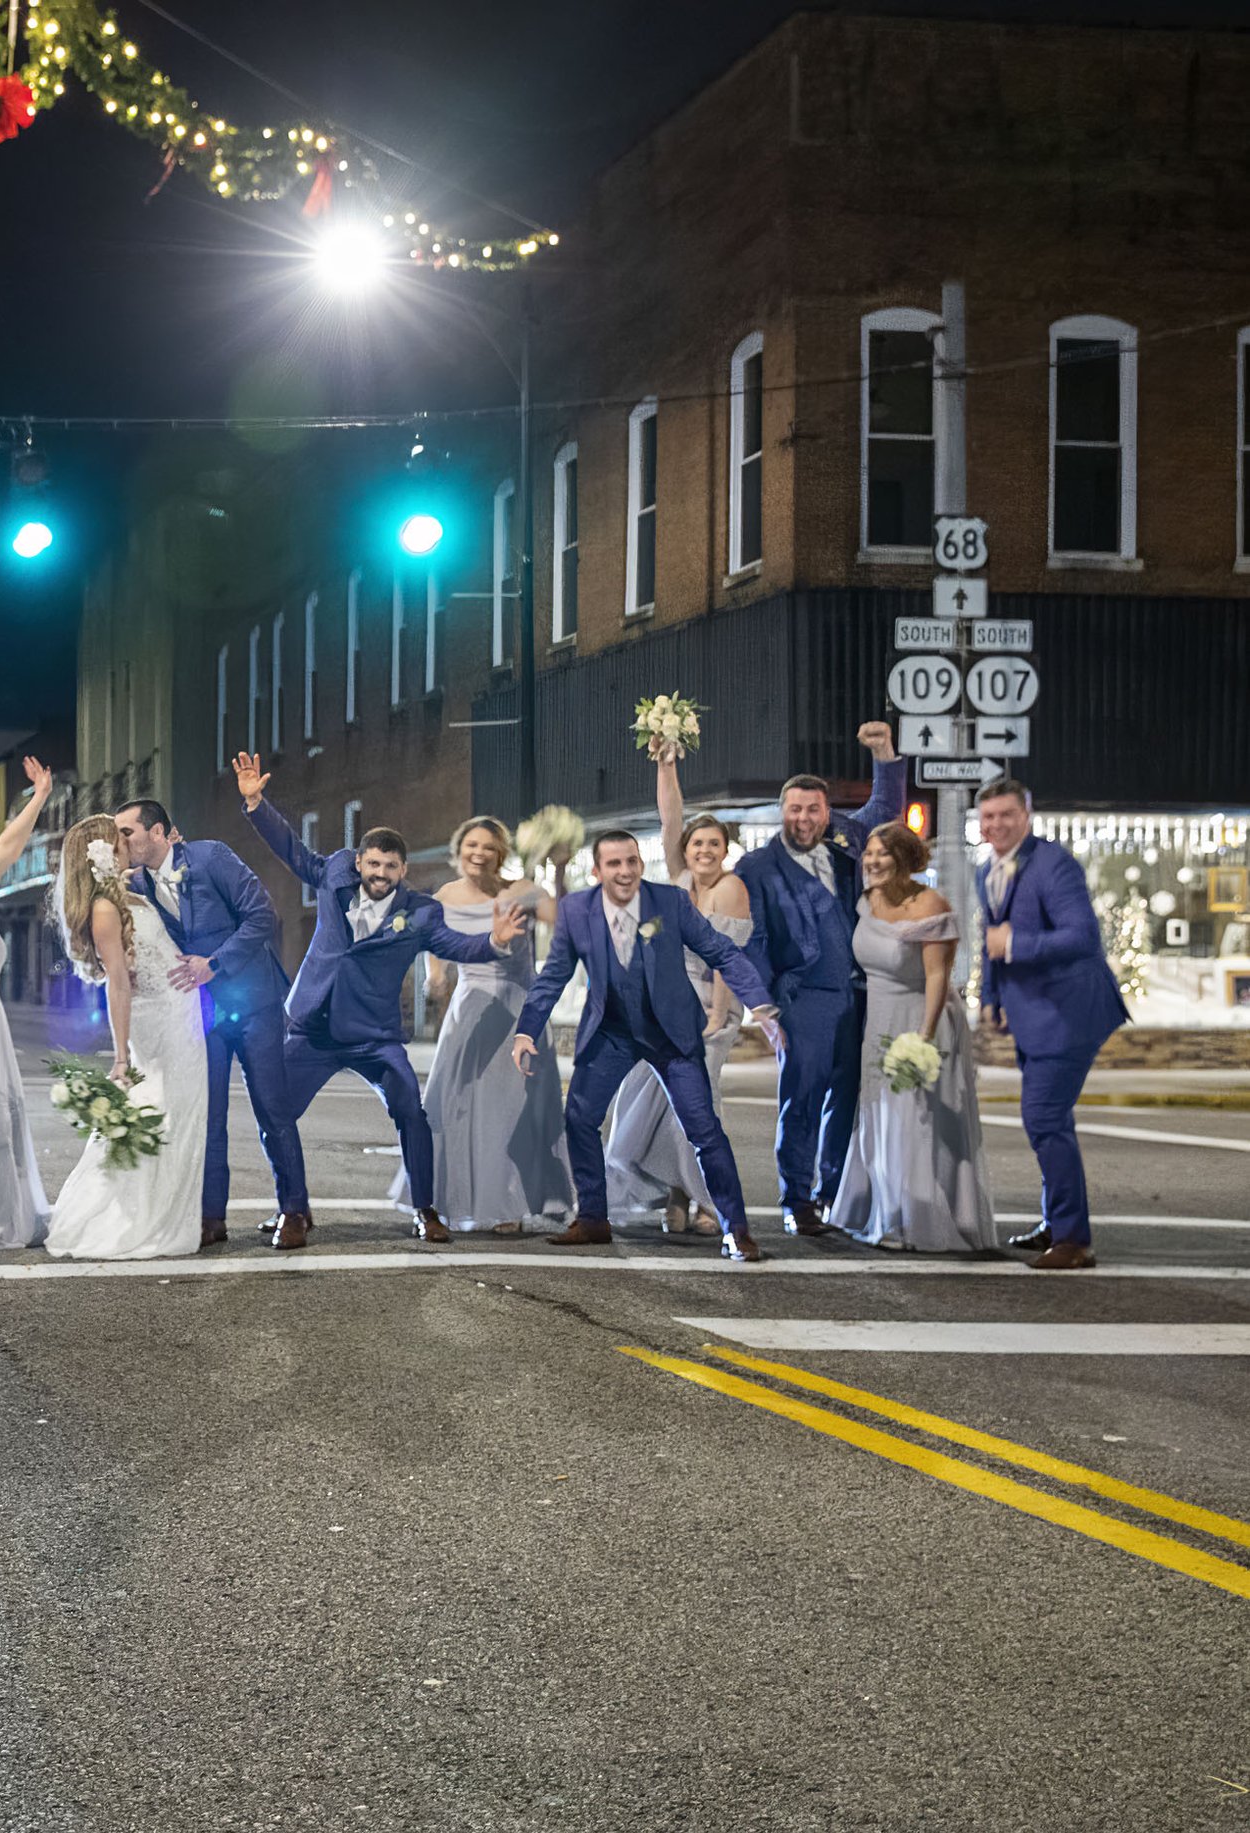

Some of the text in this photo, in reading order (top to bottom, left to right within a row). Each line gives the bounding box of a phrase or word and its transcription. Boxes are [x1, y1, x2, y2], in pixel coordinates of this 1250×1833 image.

[943, 528, 979, 561] 68
[900, 625, 951, 642] SOUTH
[977, 627, 1027, 644] SOUTH
[898, 667, 953, 700] 109
[976, 669, 1031, 701] 107
